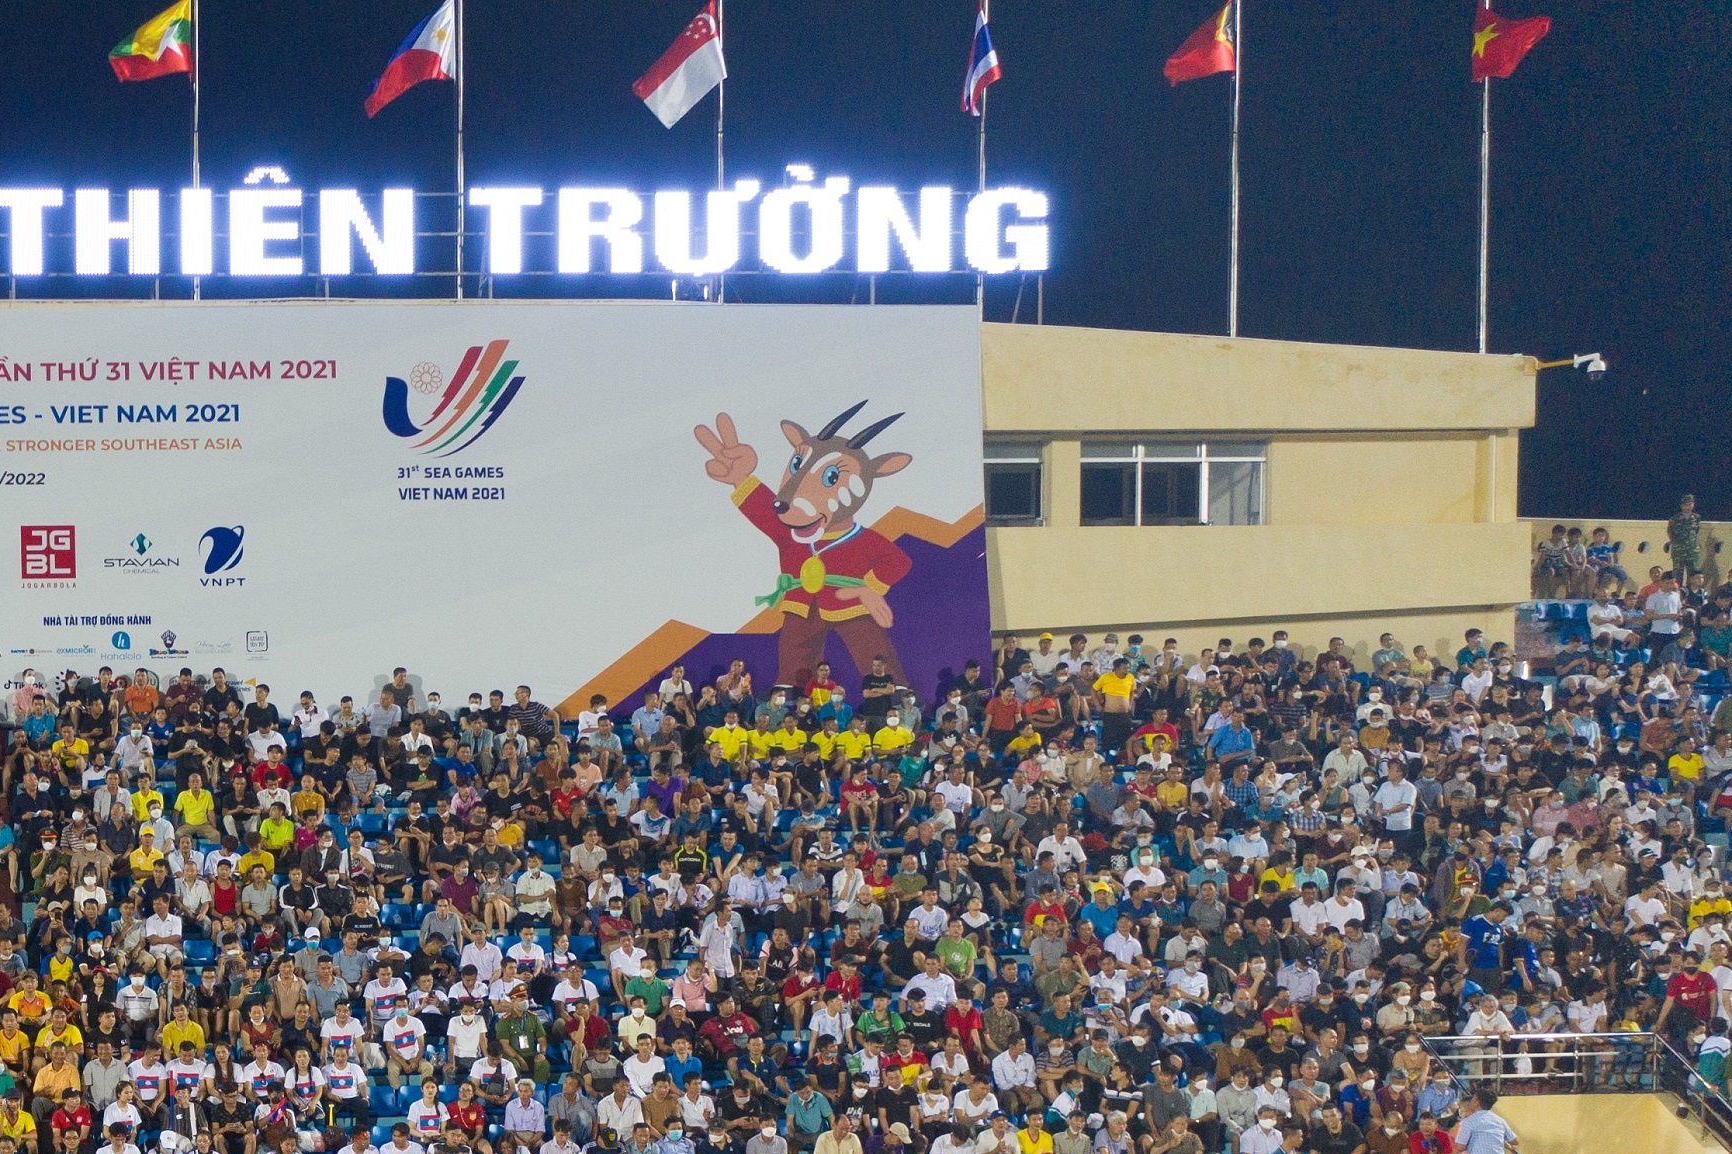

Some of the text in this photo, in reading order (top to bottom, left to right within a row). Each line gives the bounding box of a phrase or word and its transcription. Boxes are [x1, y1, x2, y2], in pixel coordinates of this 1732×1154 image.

[469, 164, 1050, 274] TRƯỜNG
[40, 357, 99, 381] THỨ
[106, 362, 130, 381] 31
[139, 356, 200, 385] VIỆT
[208, 361, 271, 380] NAM
[280, 359, 337, 379] 2021
[50, 405, 109, 424] VIET
[117, 404, 177, 423] NAM
[185, 403, 239, 423] 2021
[6, 440, 95, 451] STRONGER
[101, 439, 199, 450] SOUTHEAST
[204, 438, 242, 449] ASIA
[424, 467, 451, 479] SEA
[455, 467, 504, 478] GAMES
[398, 487, 505, 500] VIET NAM 2021
[26, 530, 70, 550] JG
[26, 555, 70, 574] BL
[104, 558, 179, 567] STAVIAN
[200, 577, 245, 587] VNPT
[43, 615, 62, 626] NHÀ
[64, 615, 78, 626] TÀI
[80, 615, 98, 627] TRỢ
[126, 614, 152, 625] HÀNH
[101, 652, 142, 660] Hahalolo
